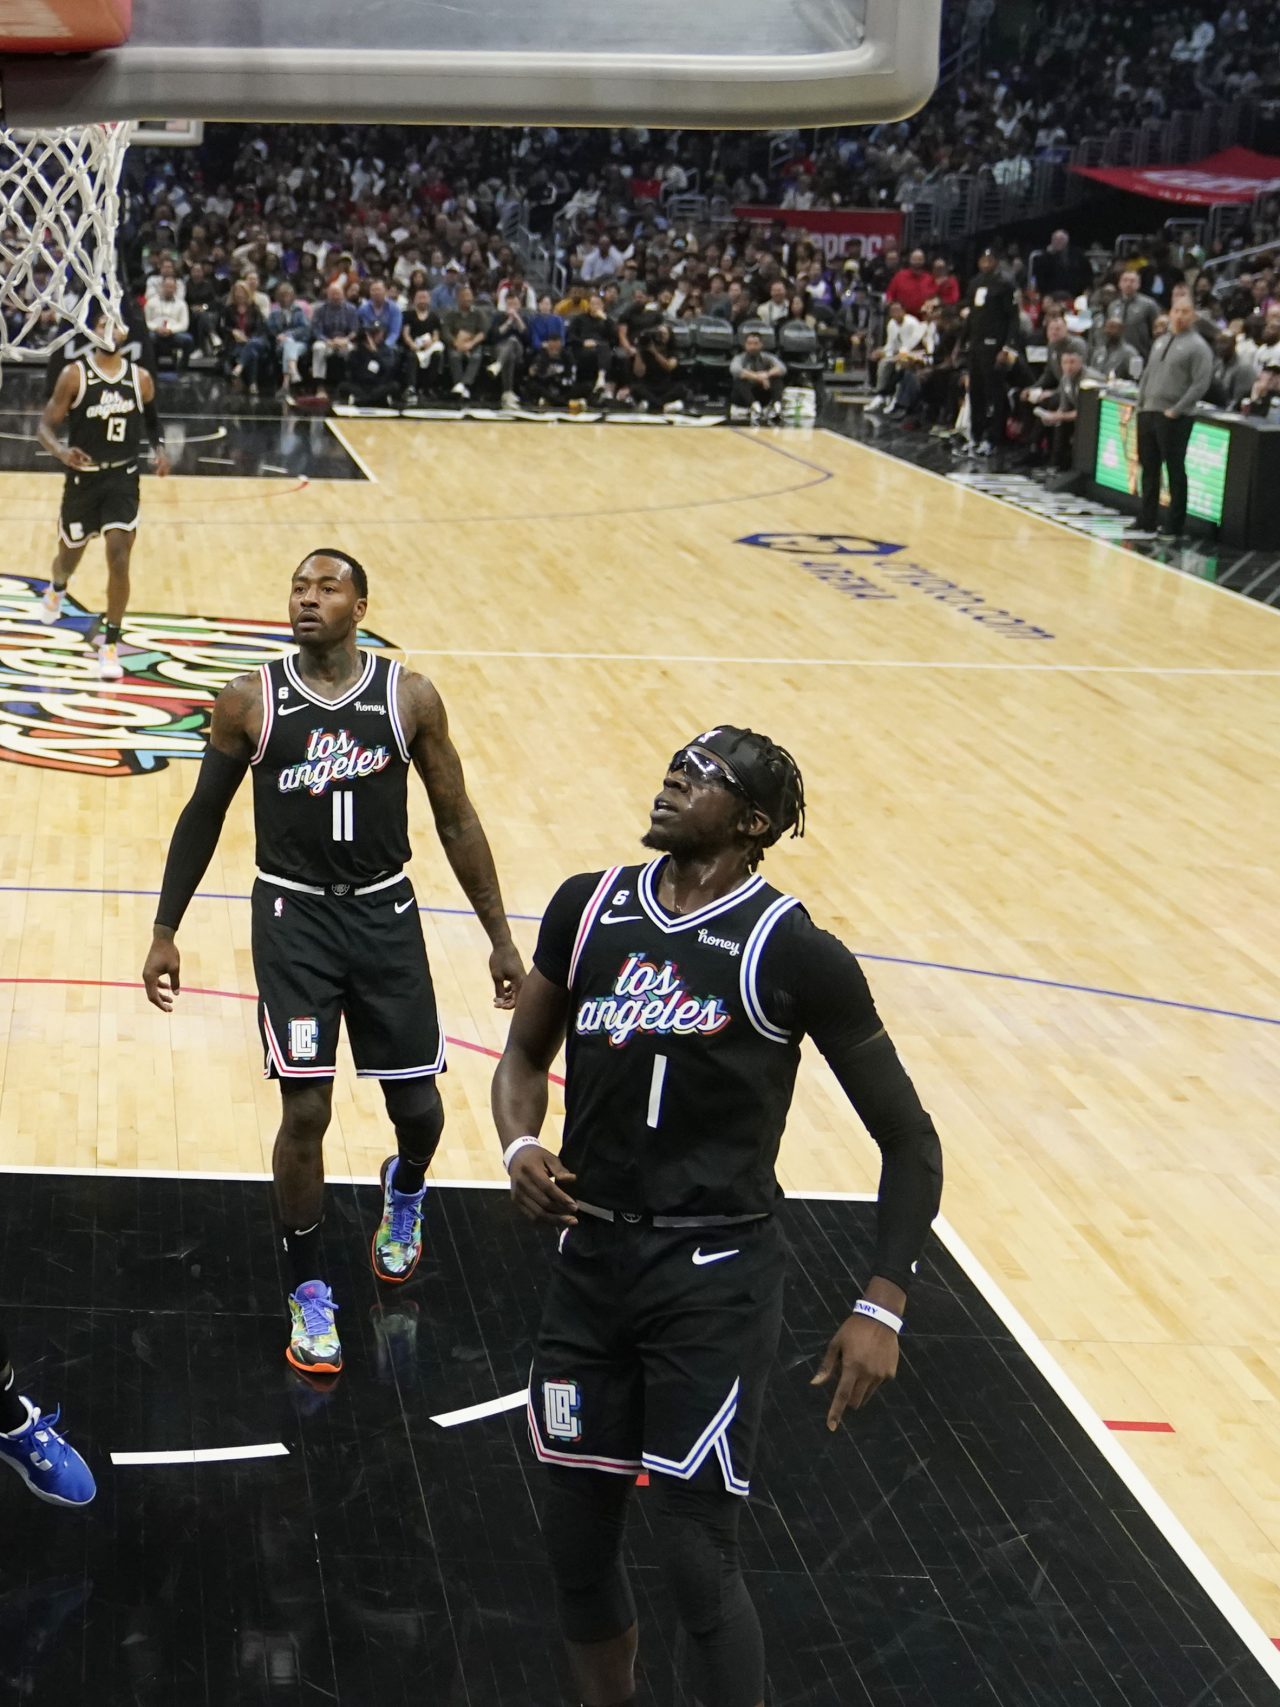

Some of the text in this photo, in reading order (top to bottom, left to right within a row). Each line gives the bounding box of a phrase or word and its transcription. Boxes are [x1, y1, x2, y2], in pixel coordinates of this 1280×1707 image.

[106, 416, 127, 442] 13
[277, 686, 289, 700] 6
[353, 701, 387, 716] honey
[306, 730, 355, 761] los
[278, 746, 390, 794] angeles
[332, 790, 354, 842] 11
[612, 889, 630, 906] 6
[697, 928, 740, 956] honey
[614, 956, 680, 996] los
[576, 991, 727, 1045] angeles
[646, 1053, 668, 1129] 1
